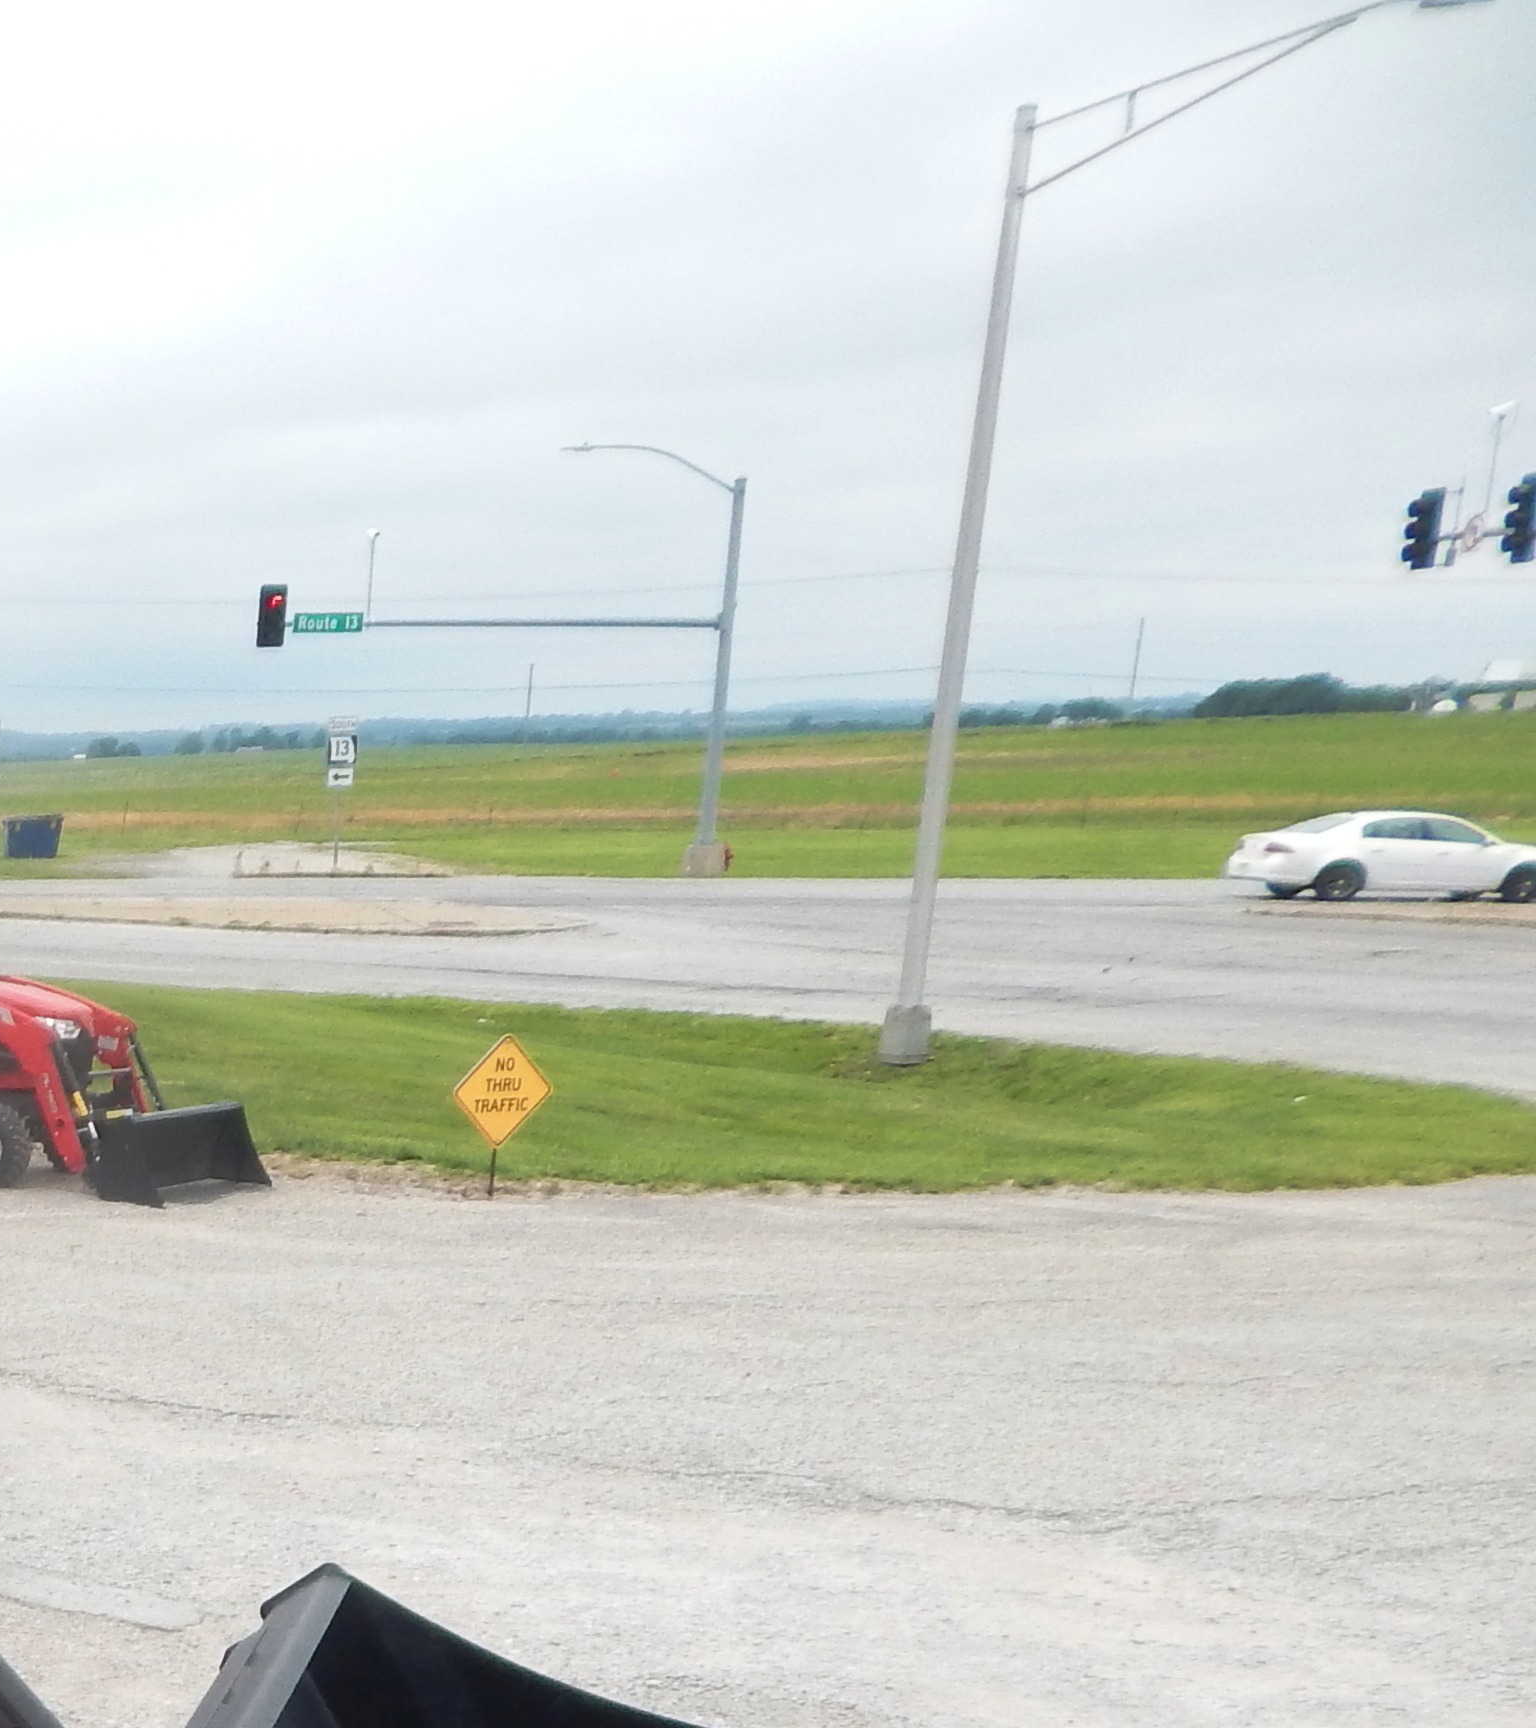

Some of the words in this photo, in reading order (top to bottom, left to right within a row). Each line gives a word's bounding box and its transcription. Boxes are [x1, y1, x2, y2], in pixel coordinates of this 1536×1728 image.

[298, 614, 338, 630] Route
[345, 614, 359, 630] 13
[335, 739, 350, 757] 13
[495, 1057, 516, 1072] NO
[486, 1077, 522, 1093] THRU
[474, 1097, 529, 1113] TRAFFIC
